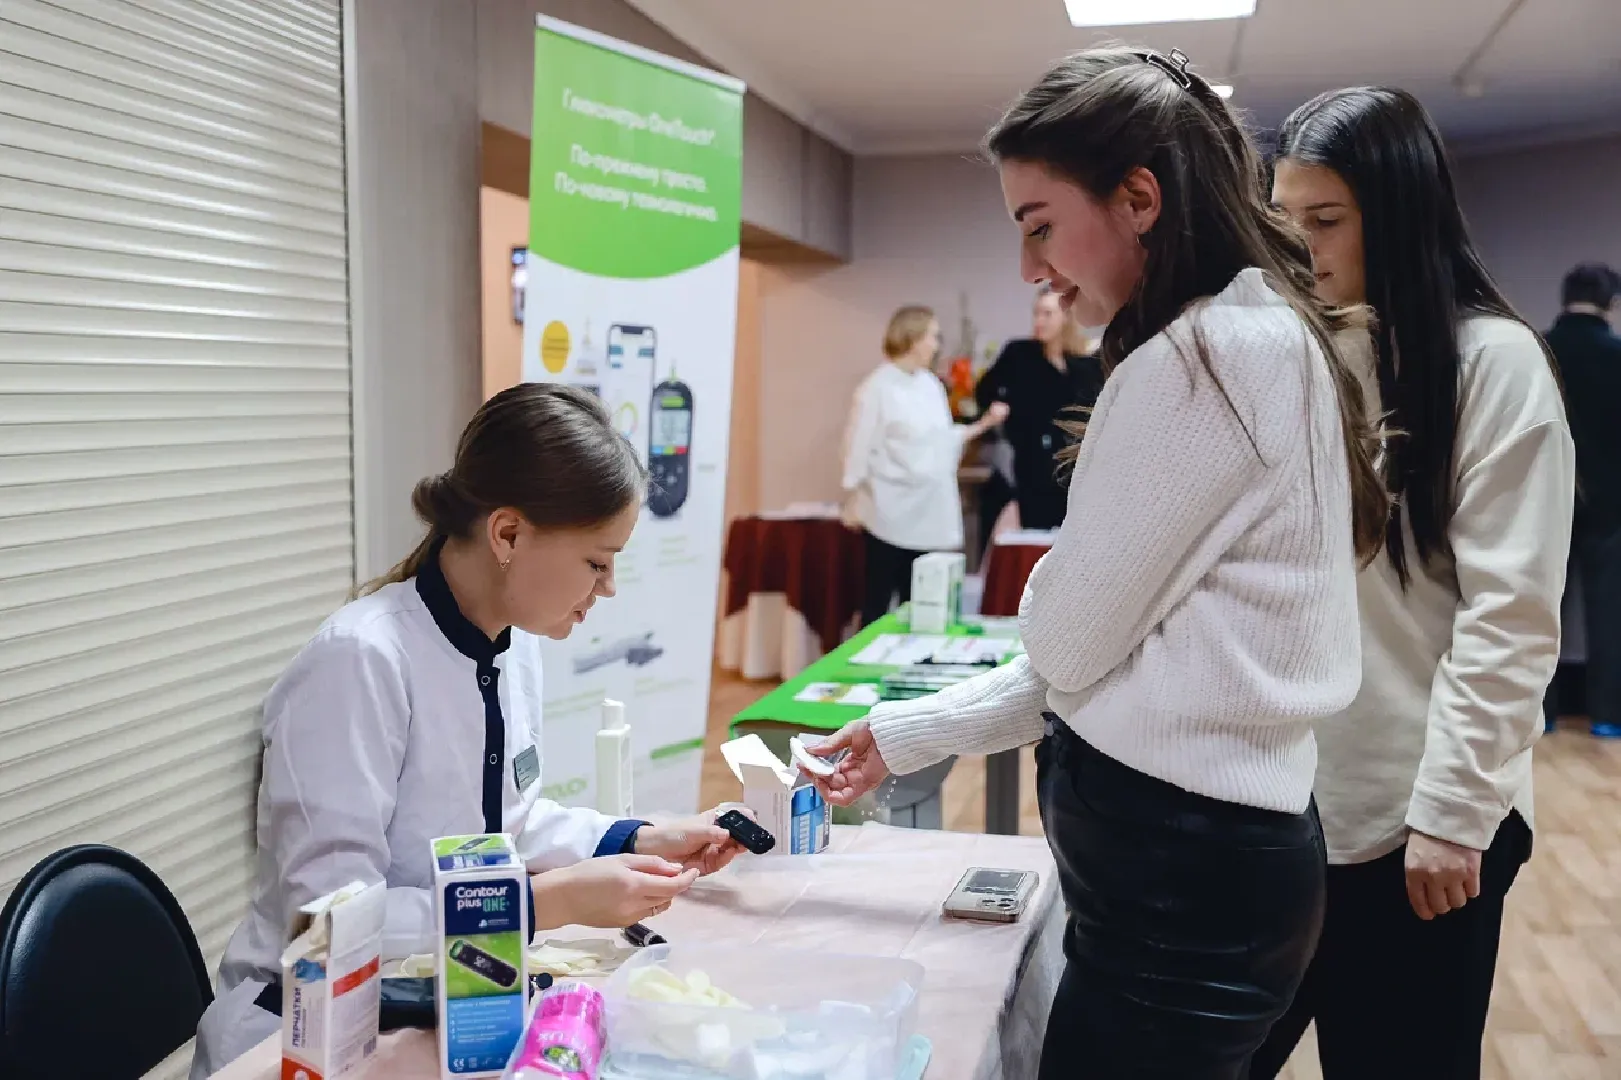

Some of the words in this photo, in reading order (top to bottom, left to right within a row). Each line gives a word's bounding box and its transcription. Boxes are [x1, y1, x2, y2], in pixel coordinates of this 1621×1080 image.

[456, 886, 508, 898] Contour
[457, 897, 482, 912] plus
[482, 897, 507, 912] ONE
[292, 987, 301, 1048] ПЕРЧАТКИ
